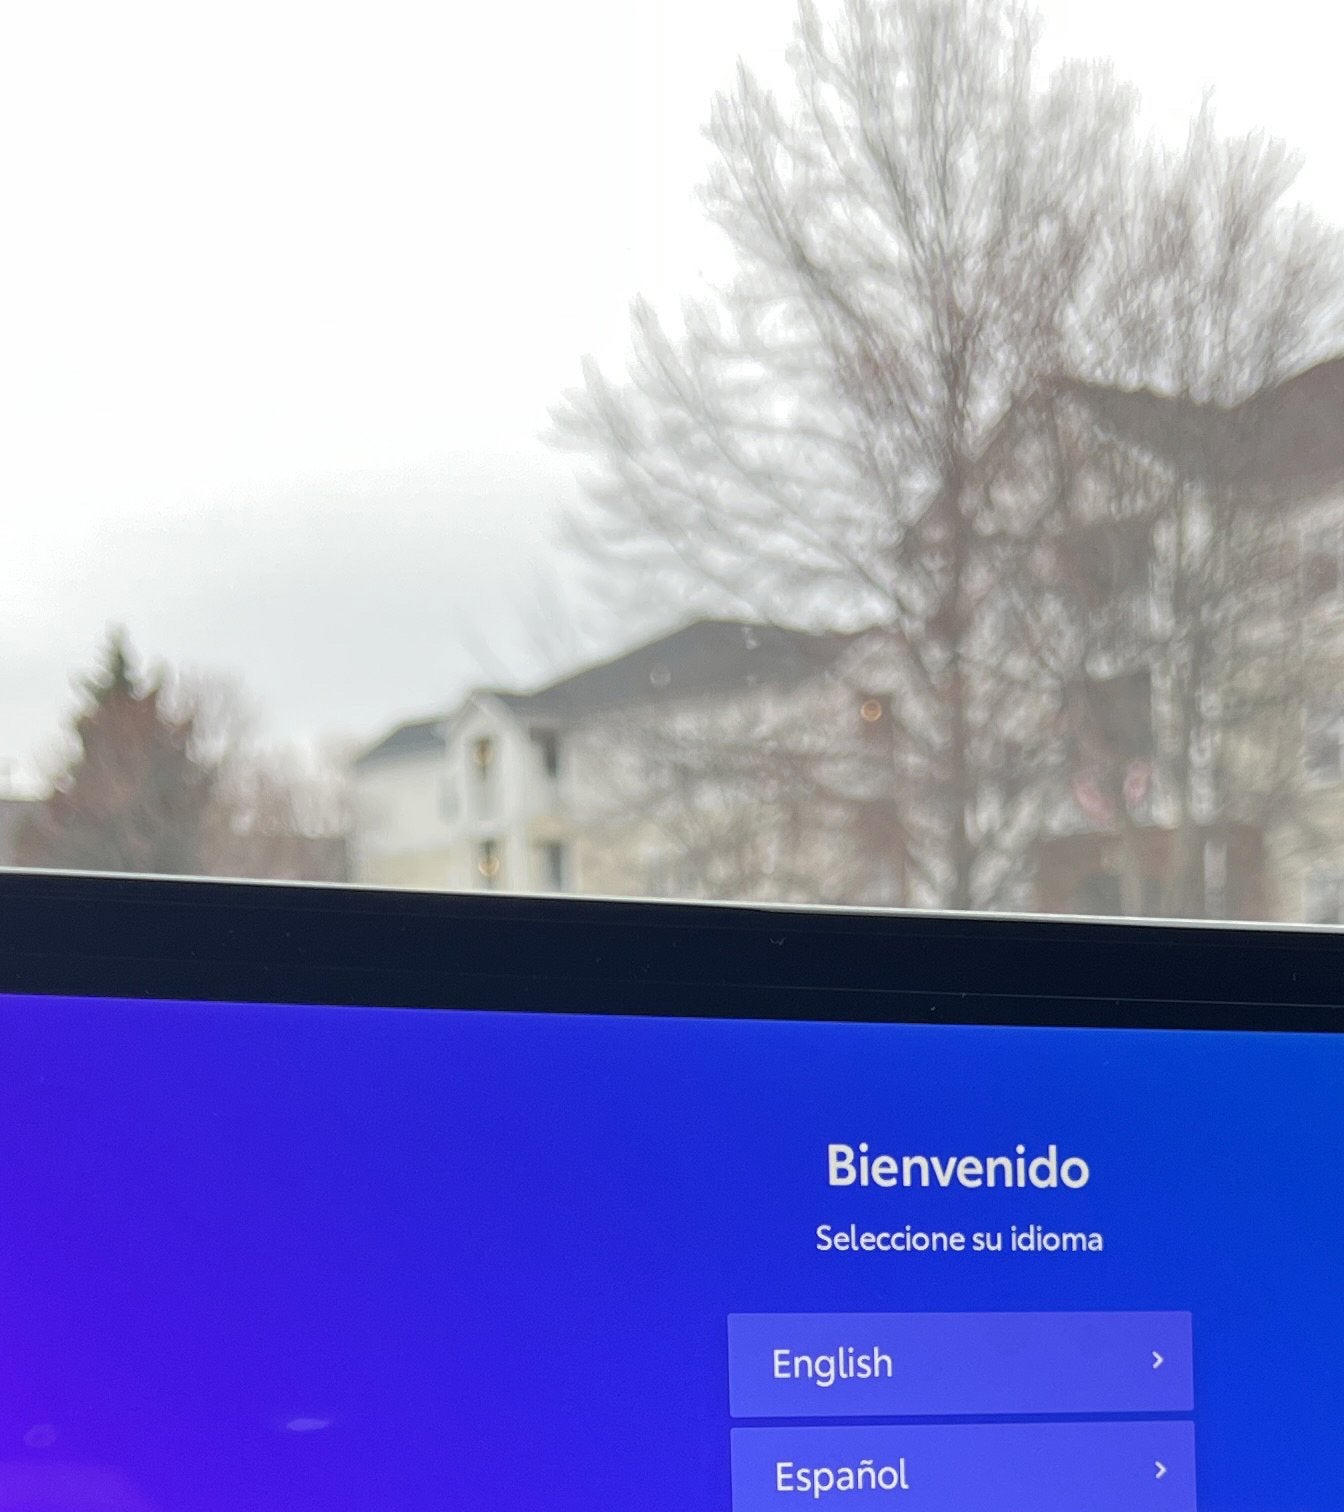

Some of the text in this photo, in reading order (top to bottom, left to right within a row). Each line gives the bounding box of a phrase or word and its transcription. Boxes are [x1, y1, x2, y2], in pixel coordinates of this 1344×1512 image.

[827, 1142, 1090, 1189] Bienvenido
[816, 1224, 1104, 1252] Seleccione su idioma
[772, 1346, 893, 1387] English
[775, 1457, 910, 1499] Español
